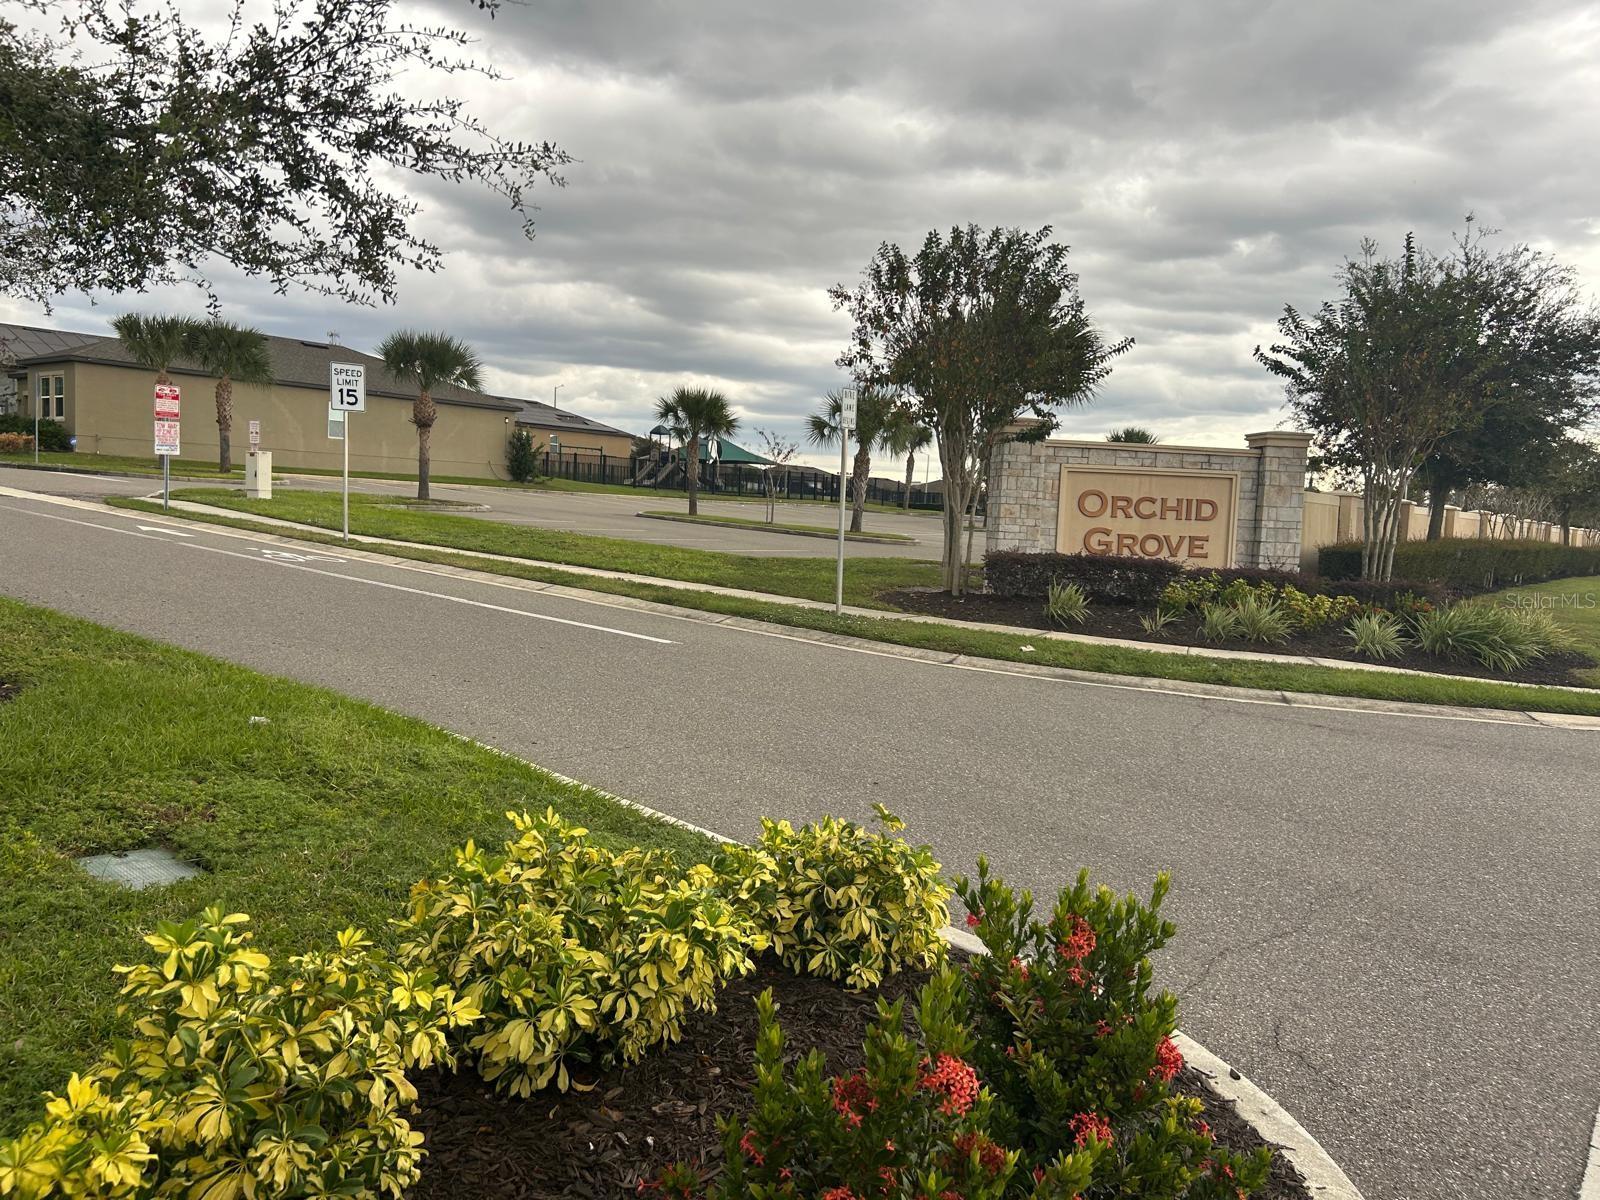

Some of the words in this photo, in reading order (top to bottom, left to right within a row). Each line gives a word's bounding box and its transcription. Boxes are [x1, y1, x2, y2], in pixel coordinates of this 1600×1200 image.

[334, 368, 362, 378] SPEED
[336, 377, 359, 387] LIMIT
[338, 388, 358, 406] 15
[1077, 488, 1219, 521] ORCHID
[1084, 527, 1210, 558] GROVE
